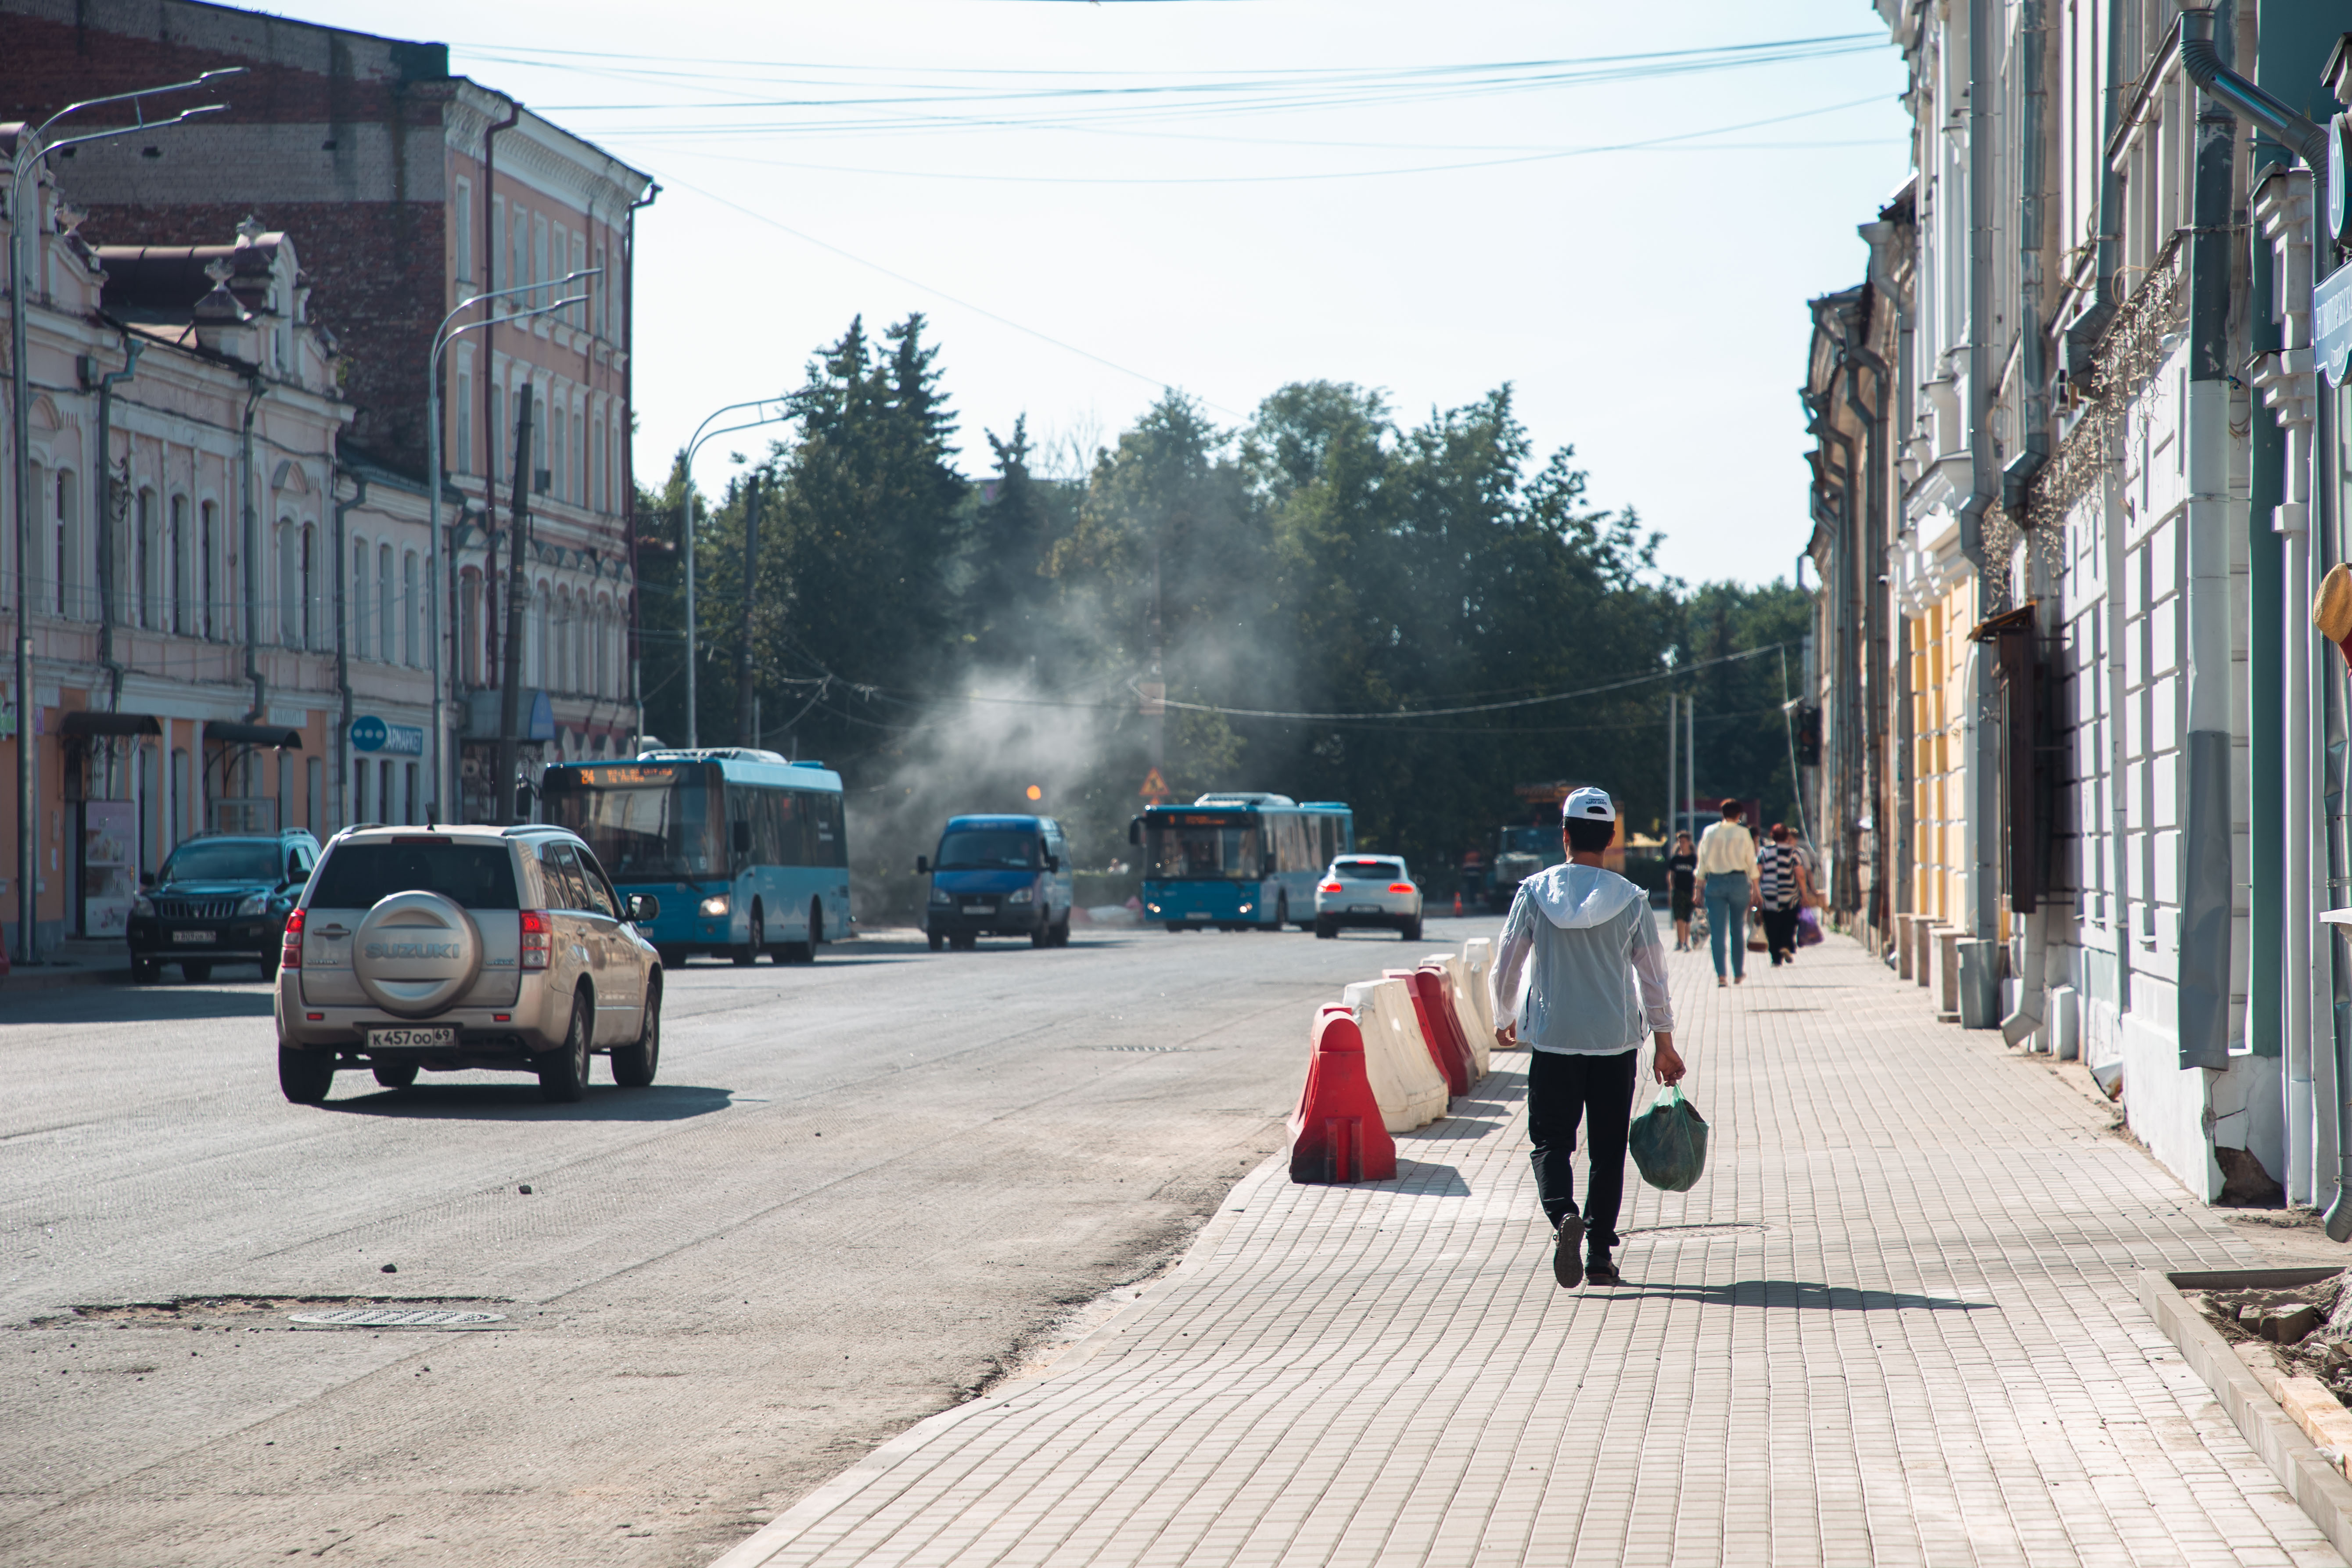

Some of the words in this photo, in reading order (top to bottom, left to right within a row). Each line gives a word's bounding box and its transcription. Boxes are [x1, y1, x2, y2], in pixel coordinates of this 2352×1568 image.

[2331, 142, 2339, 211] 17
[2316, 284, 2352, 341] НОВОТОРЖСК
[365, 943, 460, 958] SUZUKI
[435, 1030, 449, 1041] 69
